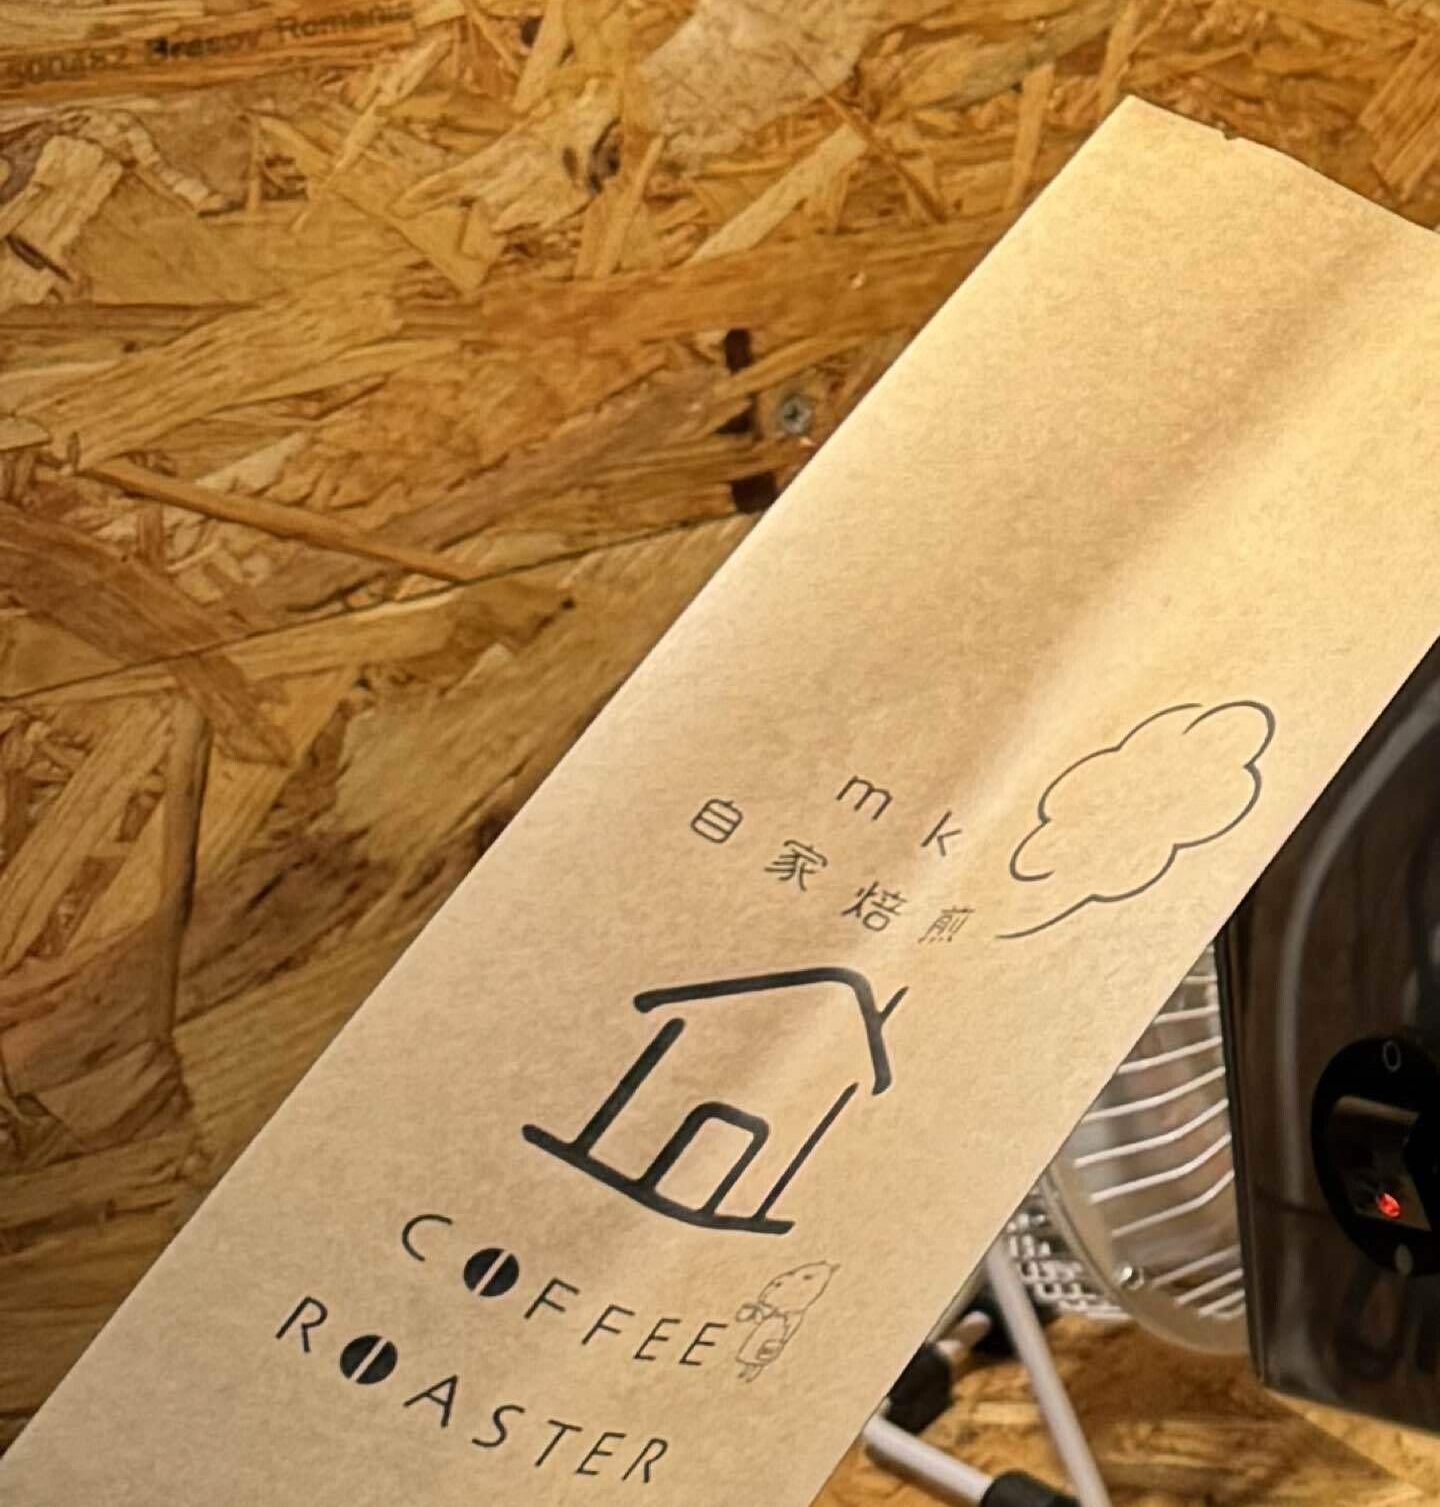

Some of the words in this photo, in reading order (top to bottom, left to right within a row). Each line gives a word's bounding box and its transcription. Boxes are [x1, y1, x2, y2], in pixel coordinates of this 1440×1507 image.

[690, 798, 977, 945] 自家焙煎
[401, 1213, 730, 1367] COFFEE
[274, 1295, 669, 1484] ROASTER
